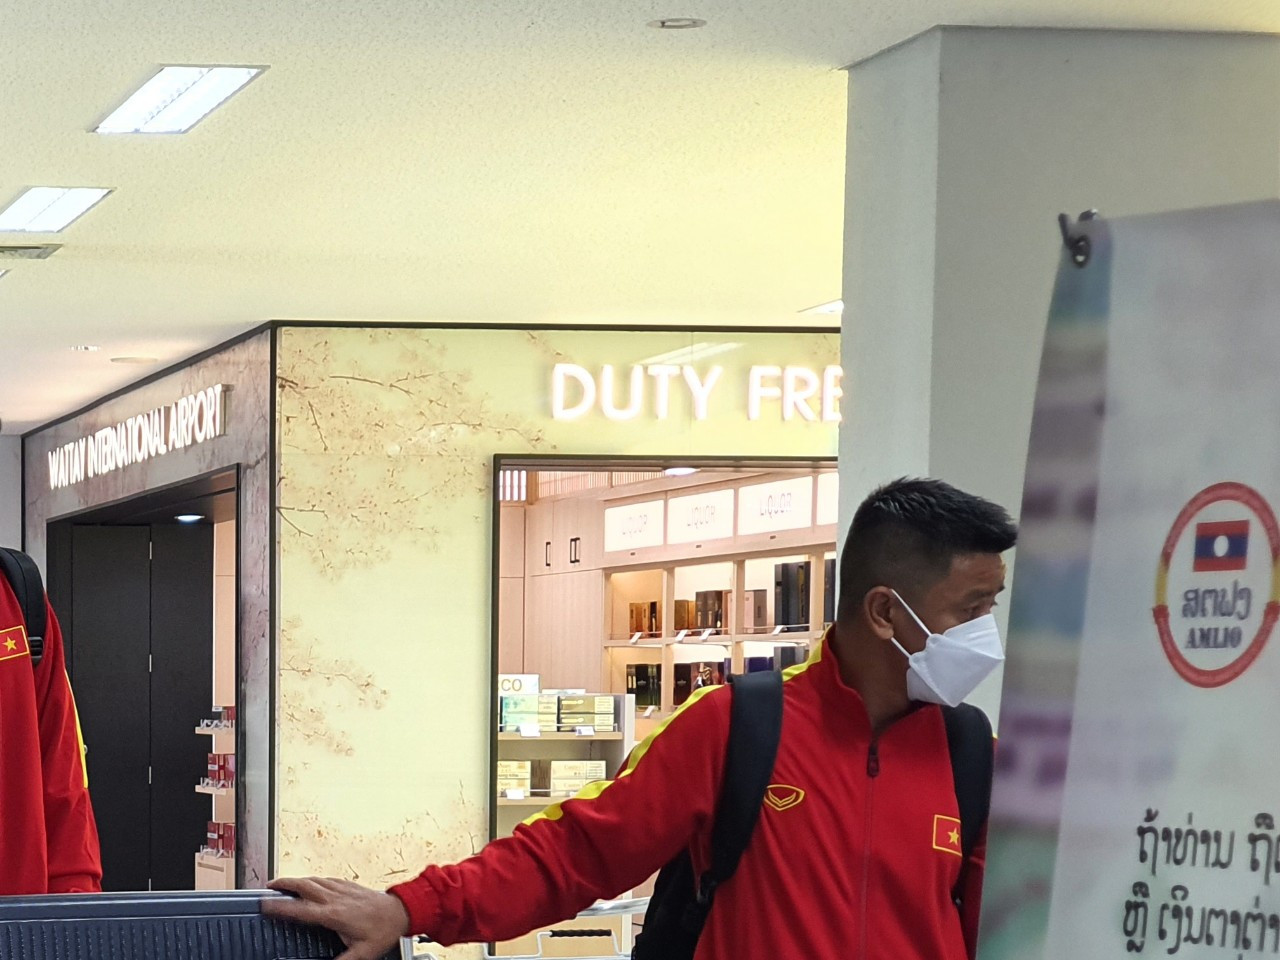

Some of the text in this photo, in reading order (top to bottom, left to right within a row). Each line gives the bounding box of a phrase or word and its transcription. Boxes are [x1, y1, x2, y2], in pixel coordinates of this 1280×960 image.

[551, 362, 723, 422] DUTY
[48, 384, 226, 490] WATTAY INTERNATIONAL AIRPORT
[759, 492, 793, 519] LIQUOR
[1137, 807, 1235, 876] ຖ້າທ່ານ
